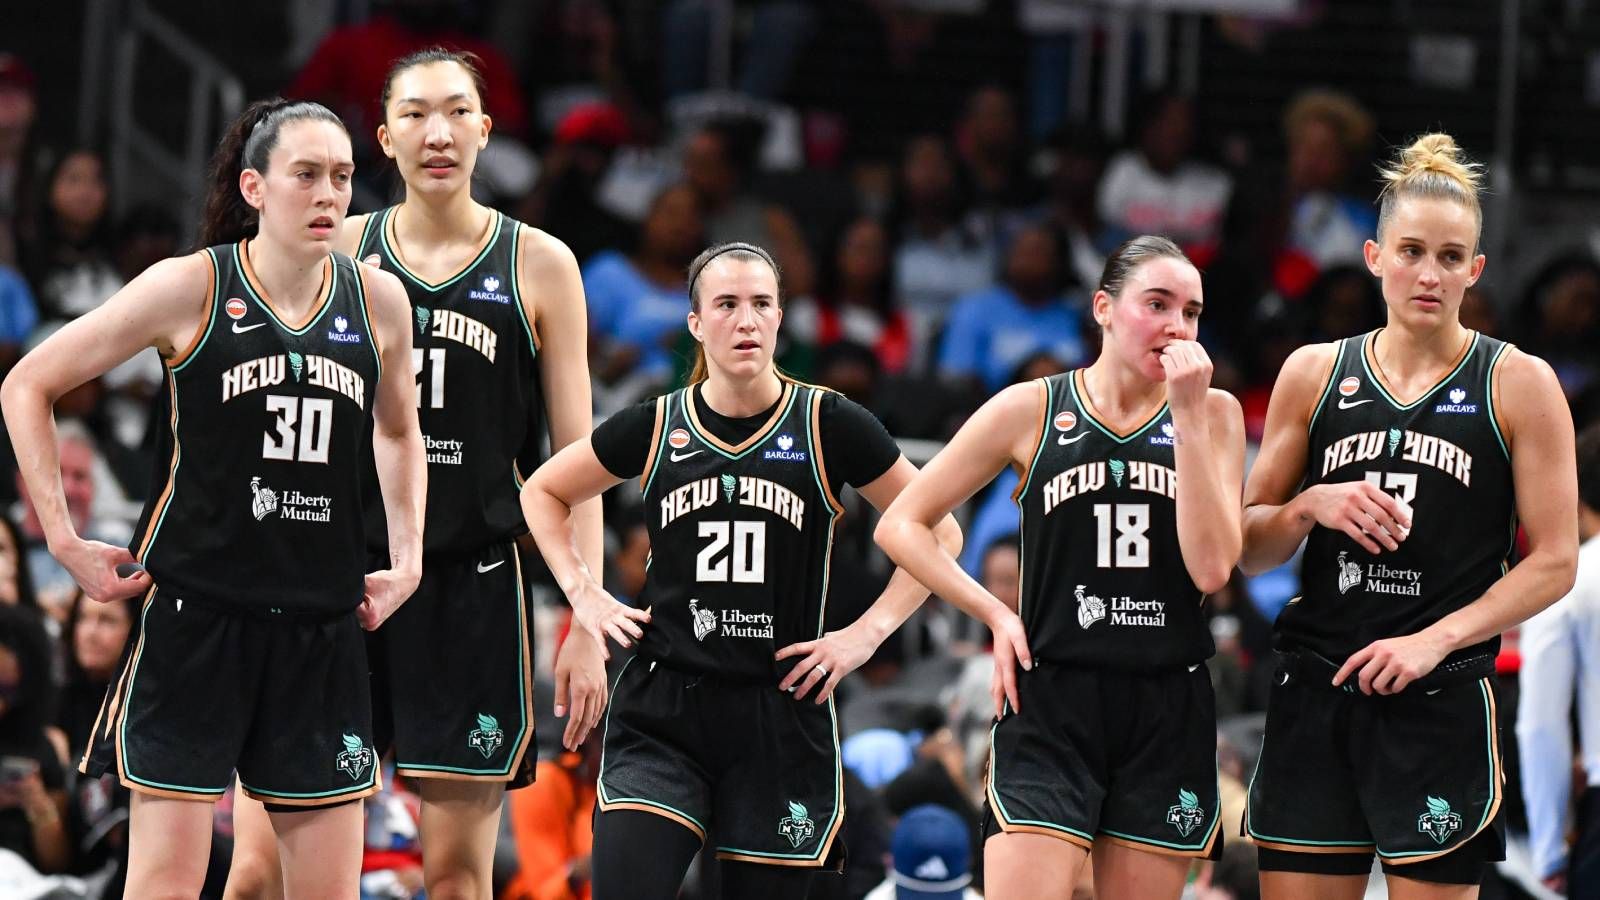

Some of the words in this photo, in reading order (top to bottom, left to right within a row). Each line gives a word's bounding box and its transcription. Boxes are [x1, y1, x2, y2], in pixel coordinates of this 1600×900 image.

[470, 290, 509, 303] BARCLAYS
[328, 331, 360, 342] BARCLAYS
[432, 309, 498, 364] YORK
[222, 354, 286, 403] NEW
[305, 354, 365, 411] YORK
[1436, 404, 1476, 413] BARCLAYS
[262, 394, 334, 464] 30
[1150, 437, 1175, 445] BARC
[427, 452, 463, 464] utual
[765, 451, 805, 460] BARCLAYS
[1322, 430, 1387, 478] NEW
[1402, 429, 1473, 488] YORK
[1043, 461, 1106, 515] NEW
[1128, 460, 1177, 500] YOR
[281, 491, 331, 511] Liberty
[661, 476, 719, 529] NEW
[739, 476, 805, 531] YORK
[280, 506, 331, 522] Mutual
[1093, 503, 1150, 568] 18
[696, 520, 766, 583] 20
[1366, 564, 1421, 585] Liberty
[1365, 579, 1421, 596] Mutual
[1111, 597, 1165, 616] Liberty
[721, 609, 773, 628] Liberty
[1110, 611, 1165, 627] Mutual
[720, 624, 774, 639] Mutual
